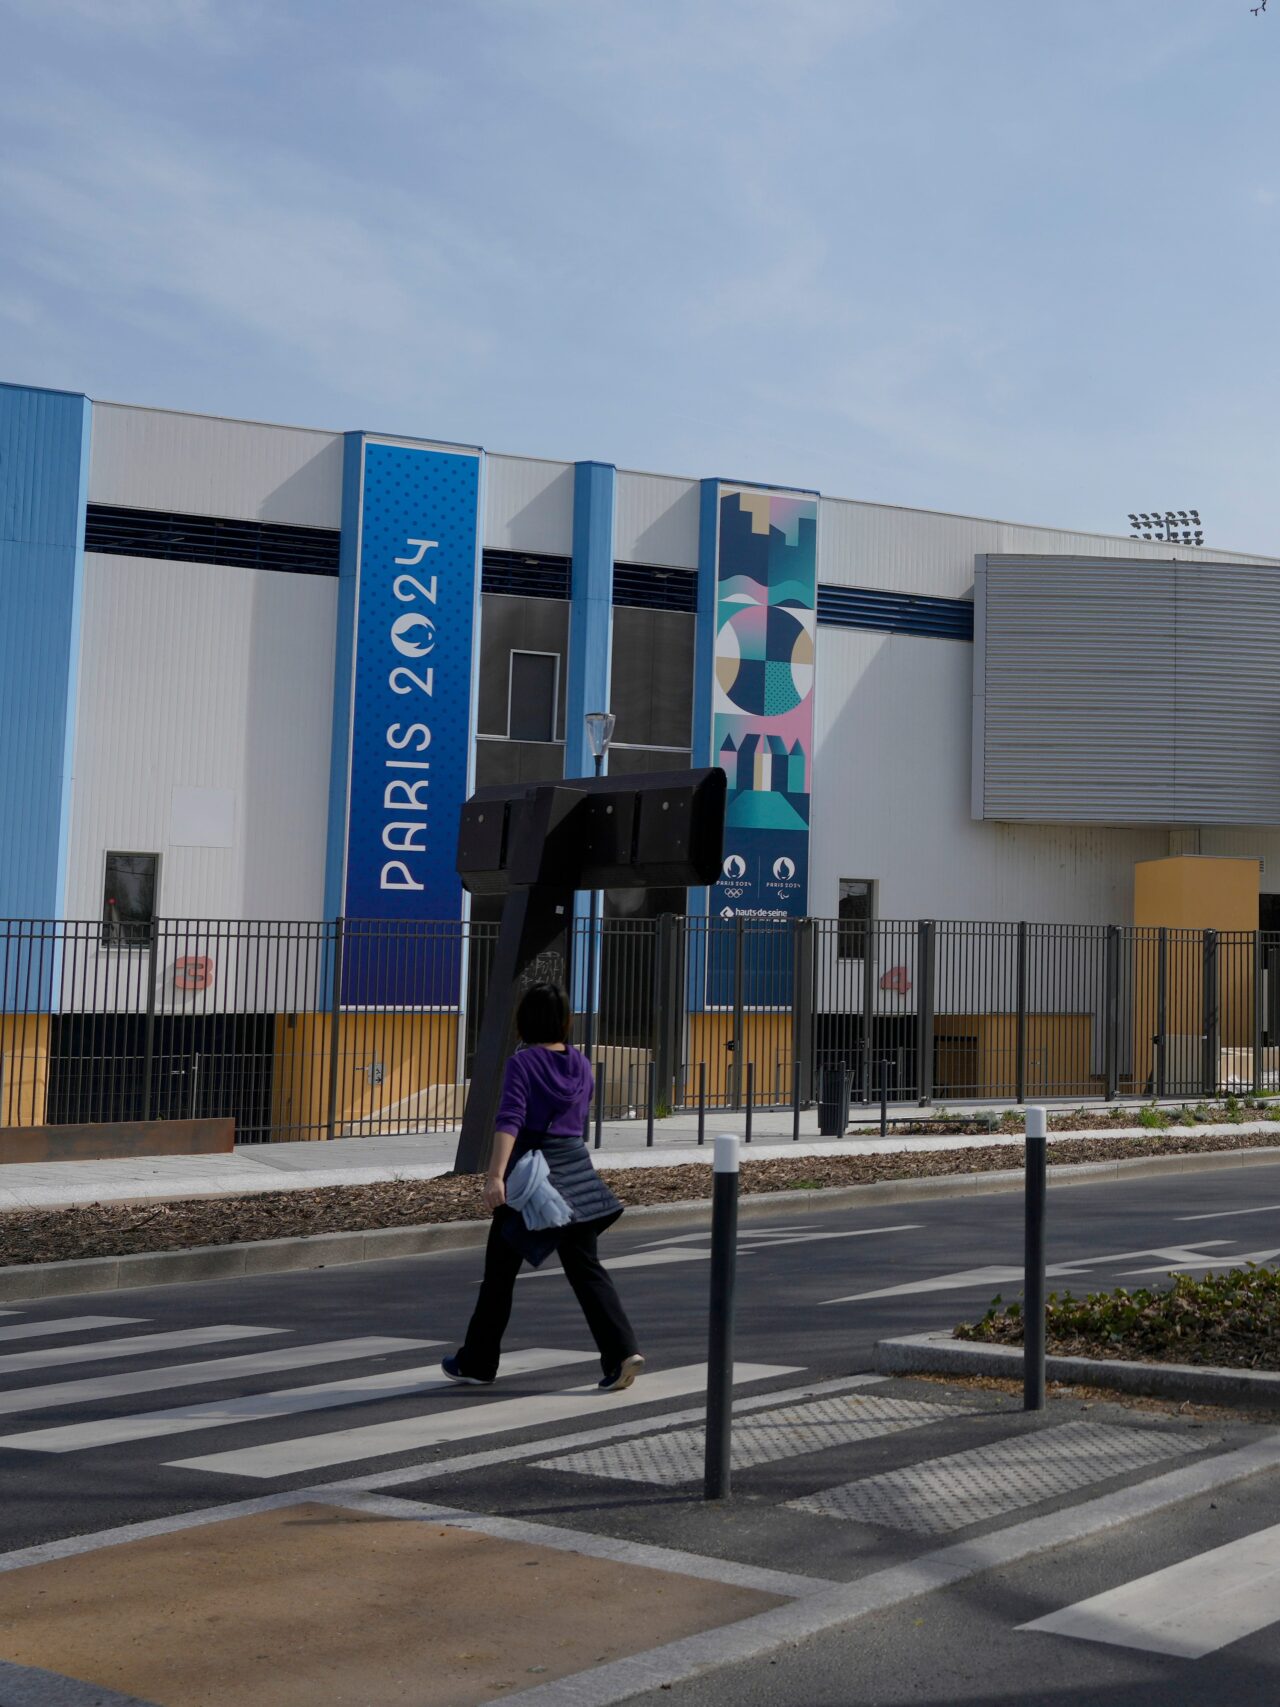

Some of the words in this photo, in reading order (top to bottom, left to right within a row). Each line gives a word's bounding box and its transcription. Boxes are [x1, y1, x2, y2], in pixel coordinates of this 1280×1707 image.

[388, 538, 439, 698] 2024
[379, 723, 432, 891] PARIS
[174, 955, 214, 991] 3
[880, 966, 913, 995] 4
